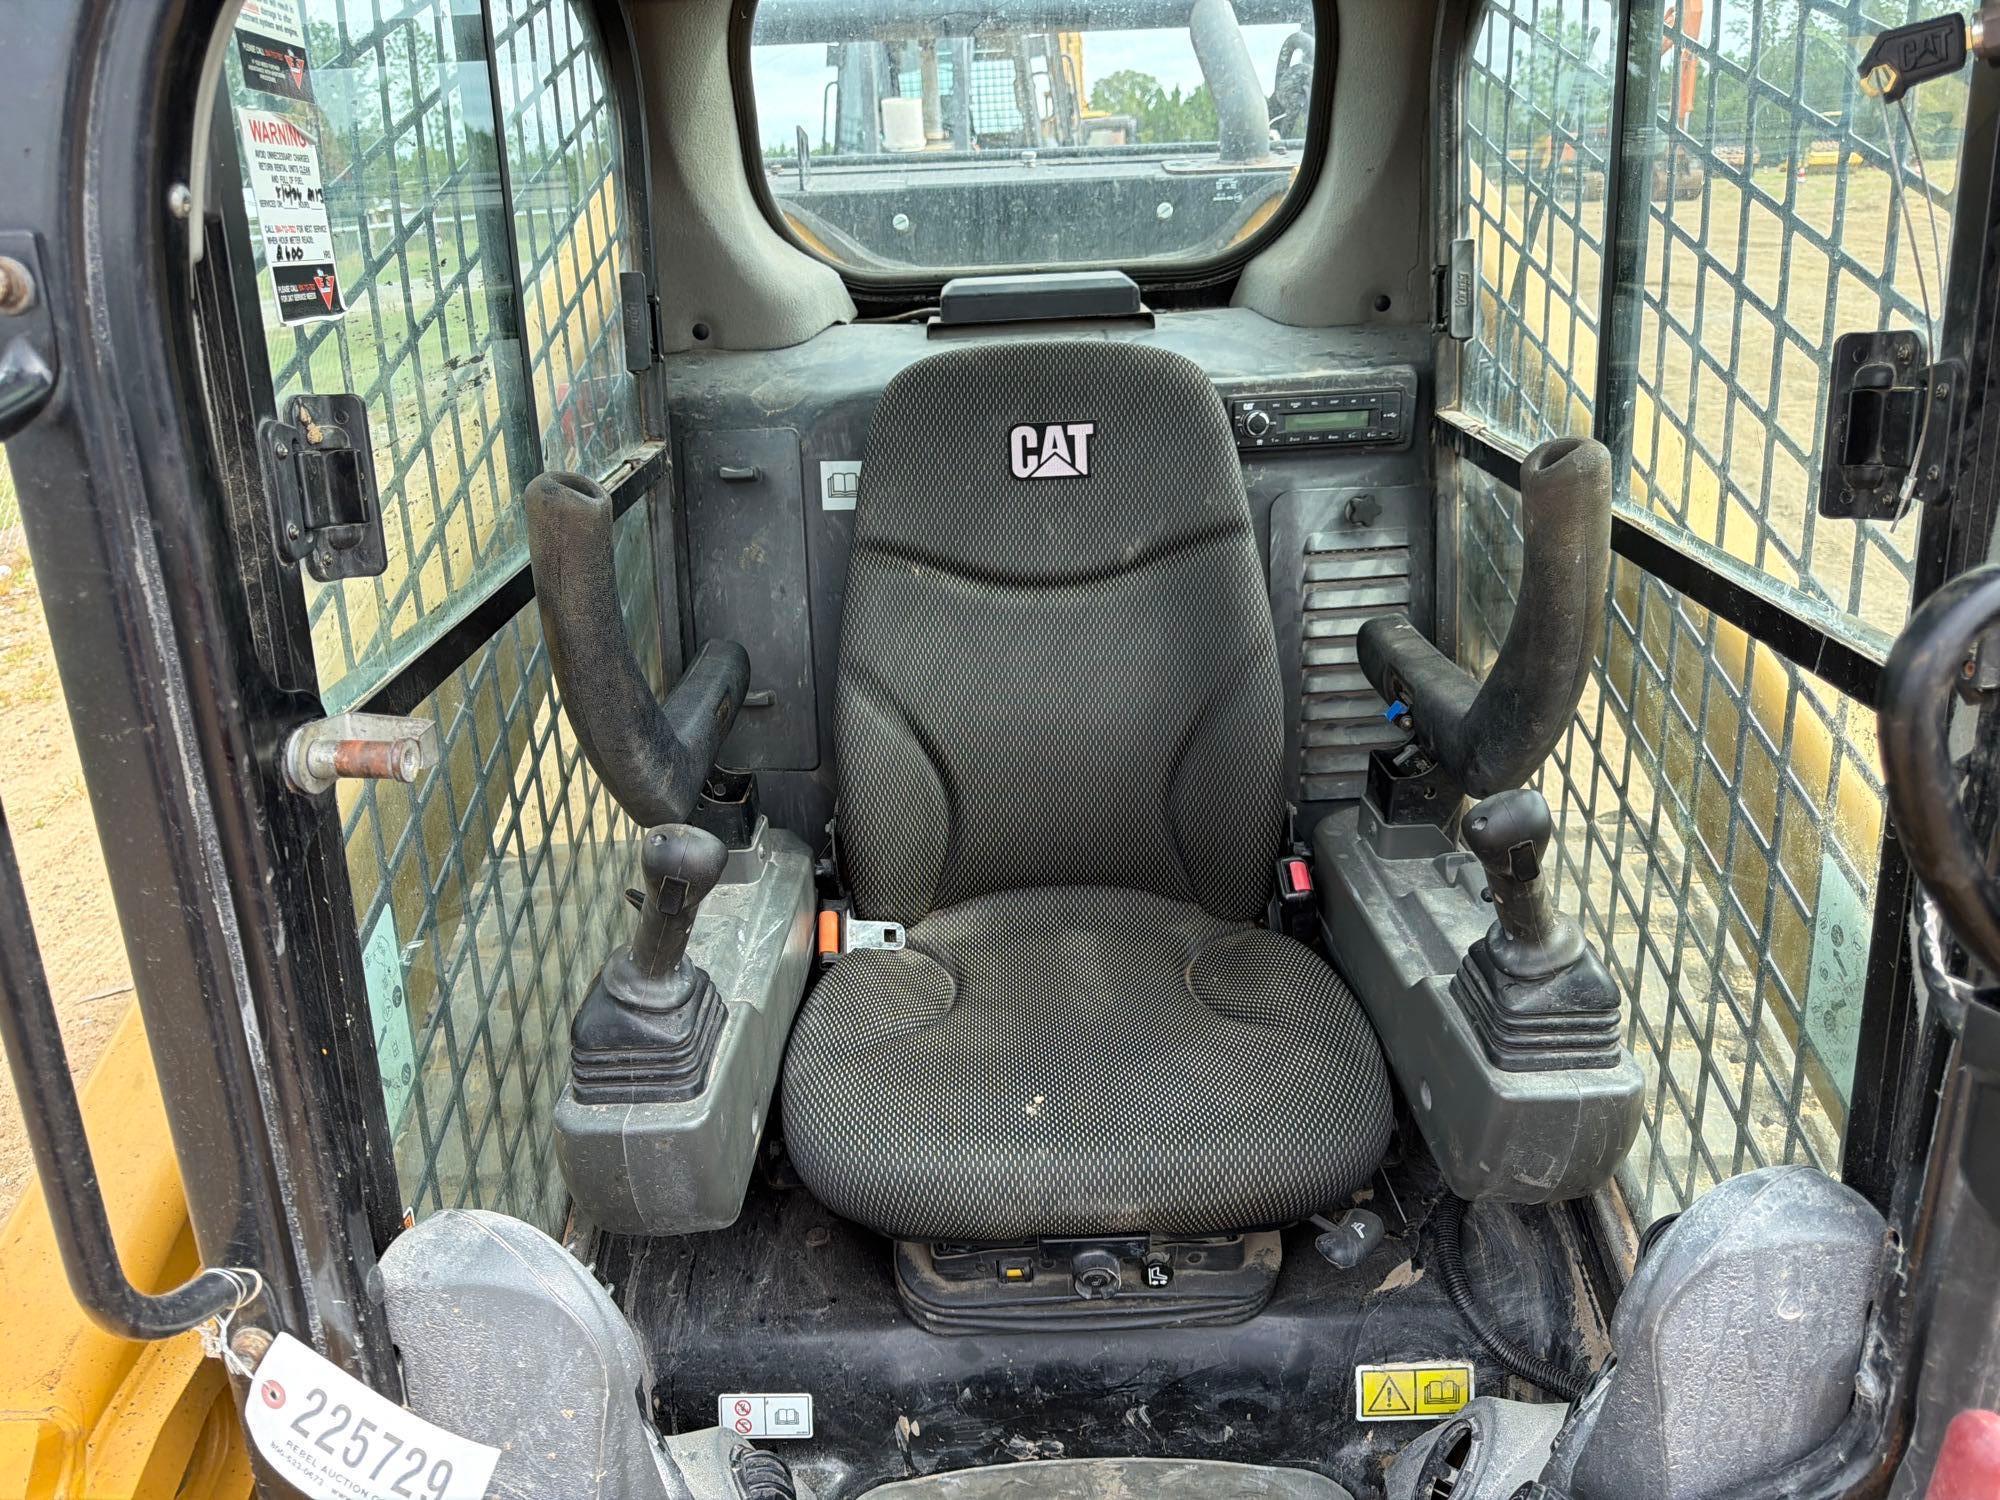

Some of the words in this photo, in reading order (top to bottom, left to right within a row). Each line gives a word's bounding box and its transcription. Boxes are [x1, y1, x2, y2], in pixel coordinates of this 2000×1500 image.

[1900, 26, 1954, 72] CAT
[249, 119, 306, 148] WARNING
[1011, 423, 1094, 479] CAT
[286, 1440, 318, 1467] REBEL
[321, 1465, 369, 1497] AUCTION
[290, 1388, 454, 1500] 225729
